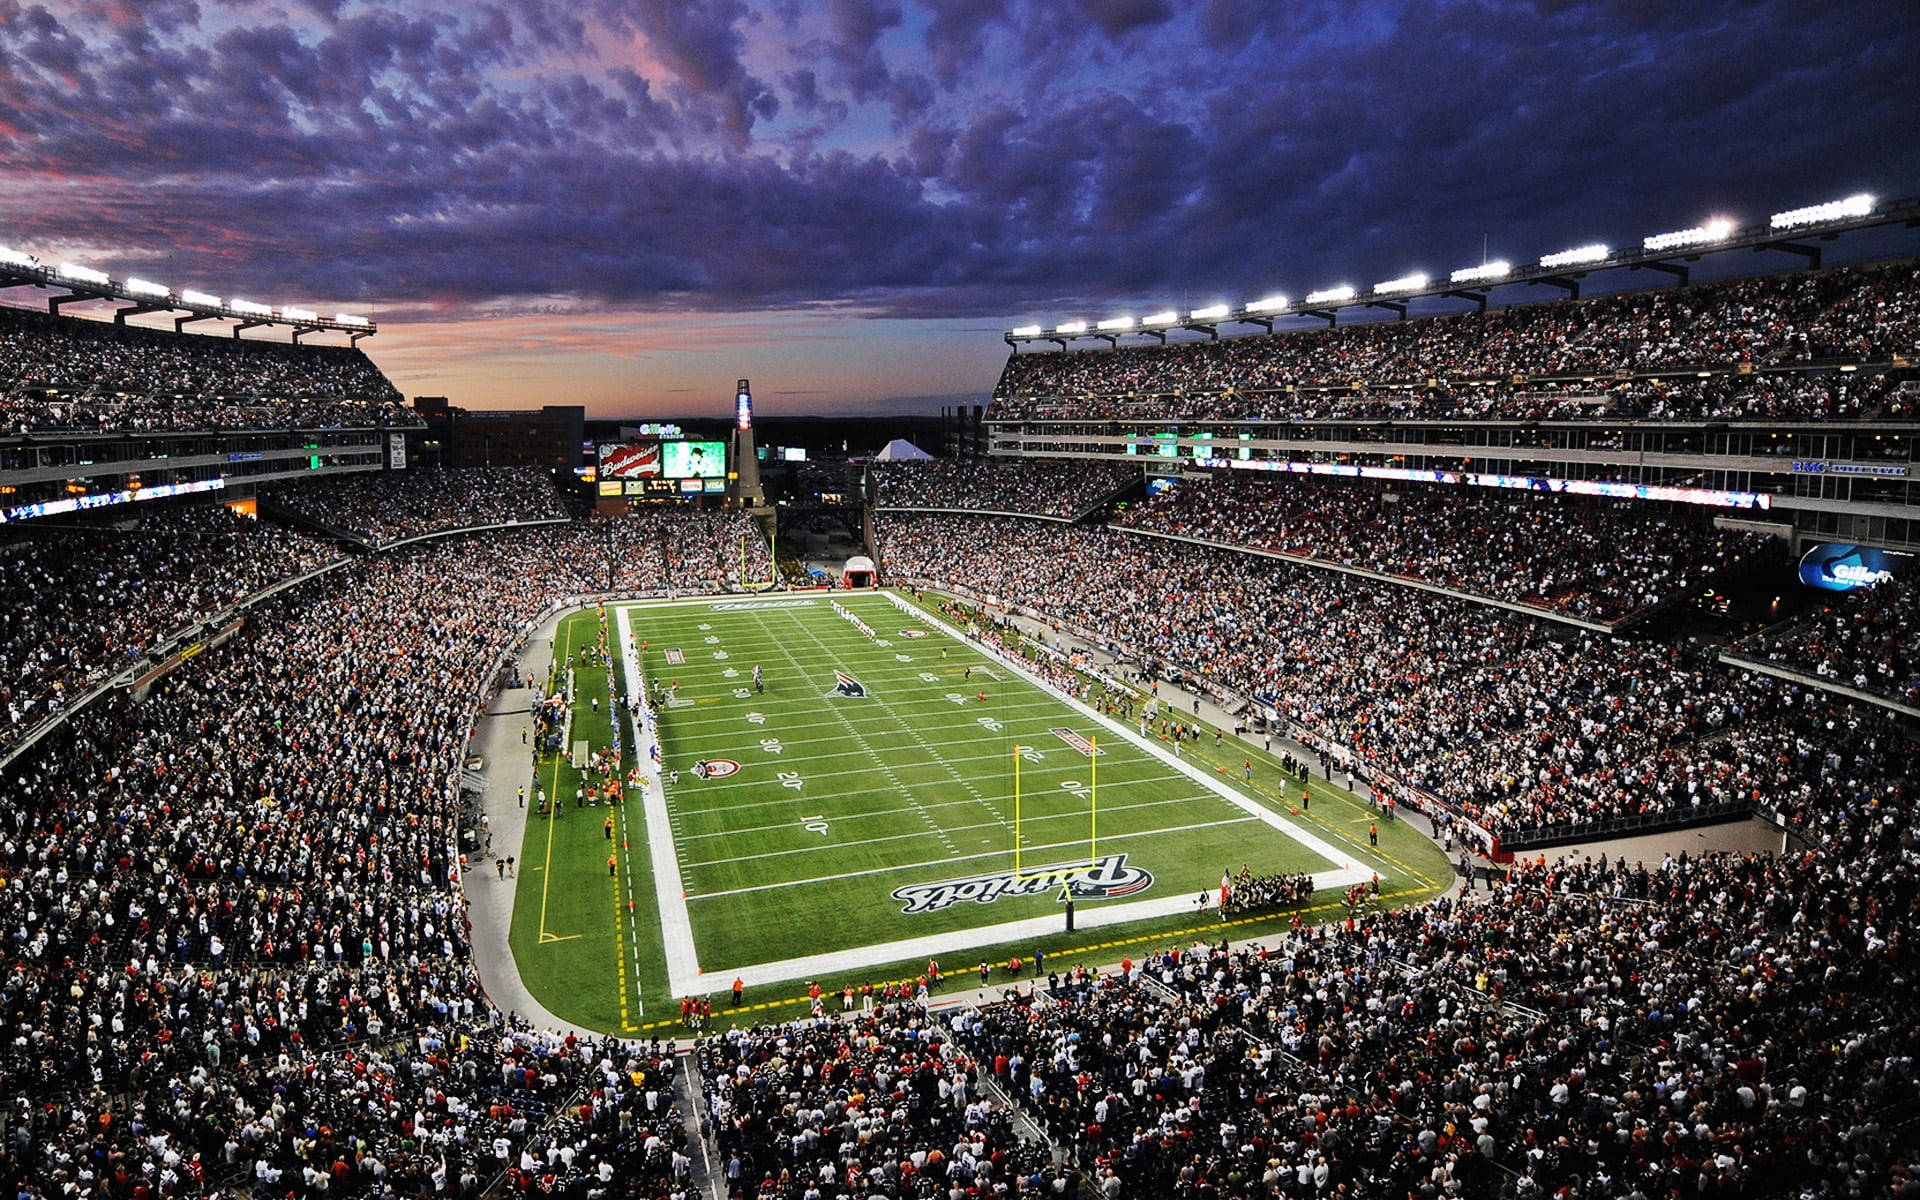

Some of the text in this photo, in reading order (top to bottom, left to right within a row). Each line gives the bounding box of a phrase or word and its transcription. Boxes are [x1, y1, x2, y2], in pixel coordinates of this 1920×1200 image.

[600, 444, 659, 477] Budweiser
[760, 738, 783, 752] 30
[777, 771, 804, 788] 20
[800, 815, 829, 833] 10
